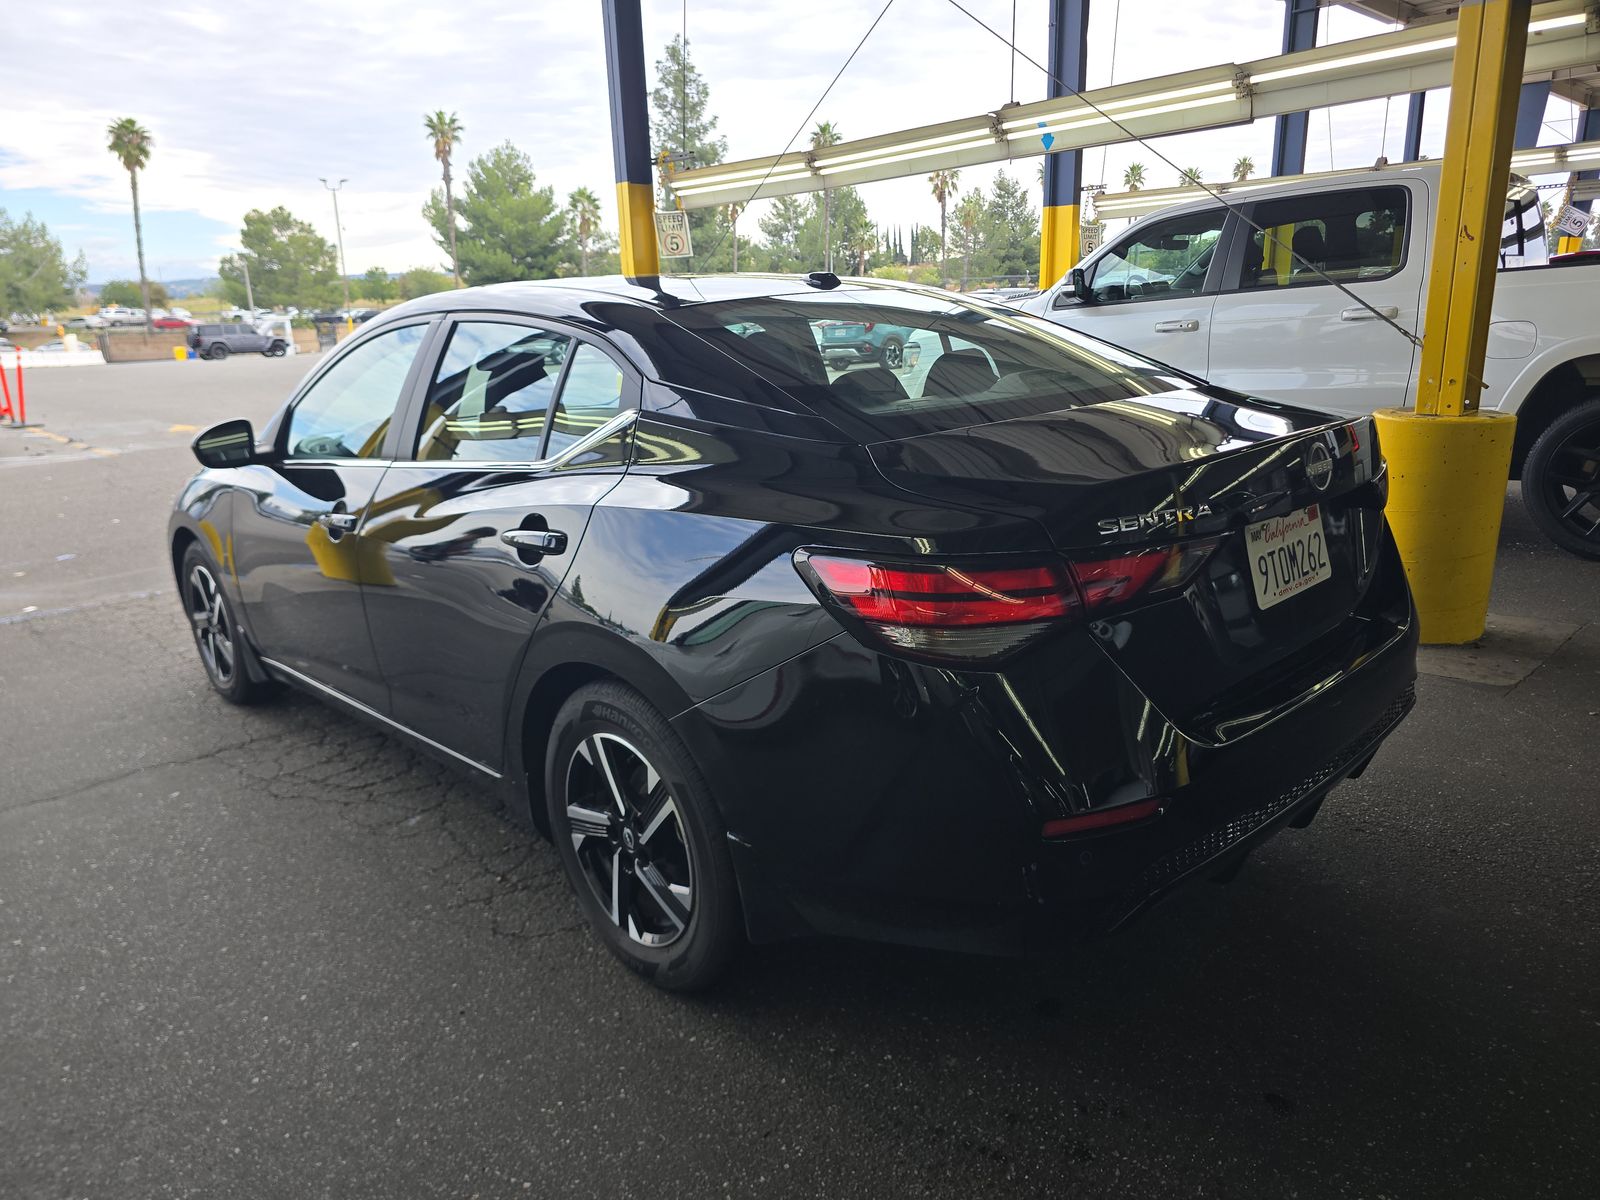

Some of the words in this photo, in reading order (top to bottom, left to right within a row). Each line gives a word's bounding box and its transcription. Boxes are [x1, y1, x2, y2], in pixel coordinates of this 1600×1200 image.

[657, 215, 683, 224] SPEED
[1572, 218, 1583, 228] 5
[662, 224, 683, 232] LIMIT
[670, 236, 679, 251] 5
[1087, 242, 1094, 253] 5
[1306, 459, 1333, 476] NISS
[1098, 504, 1212, 535] SENTRA
[1264, 515, 1310, 544] California
[1258, 531, 1327, 595] 9TOM262
[1278, 575, 1316, 597] dmv.ca.gov
